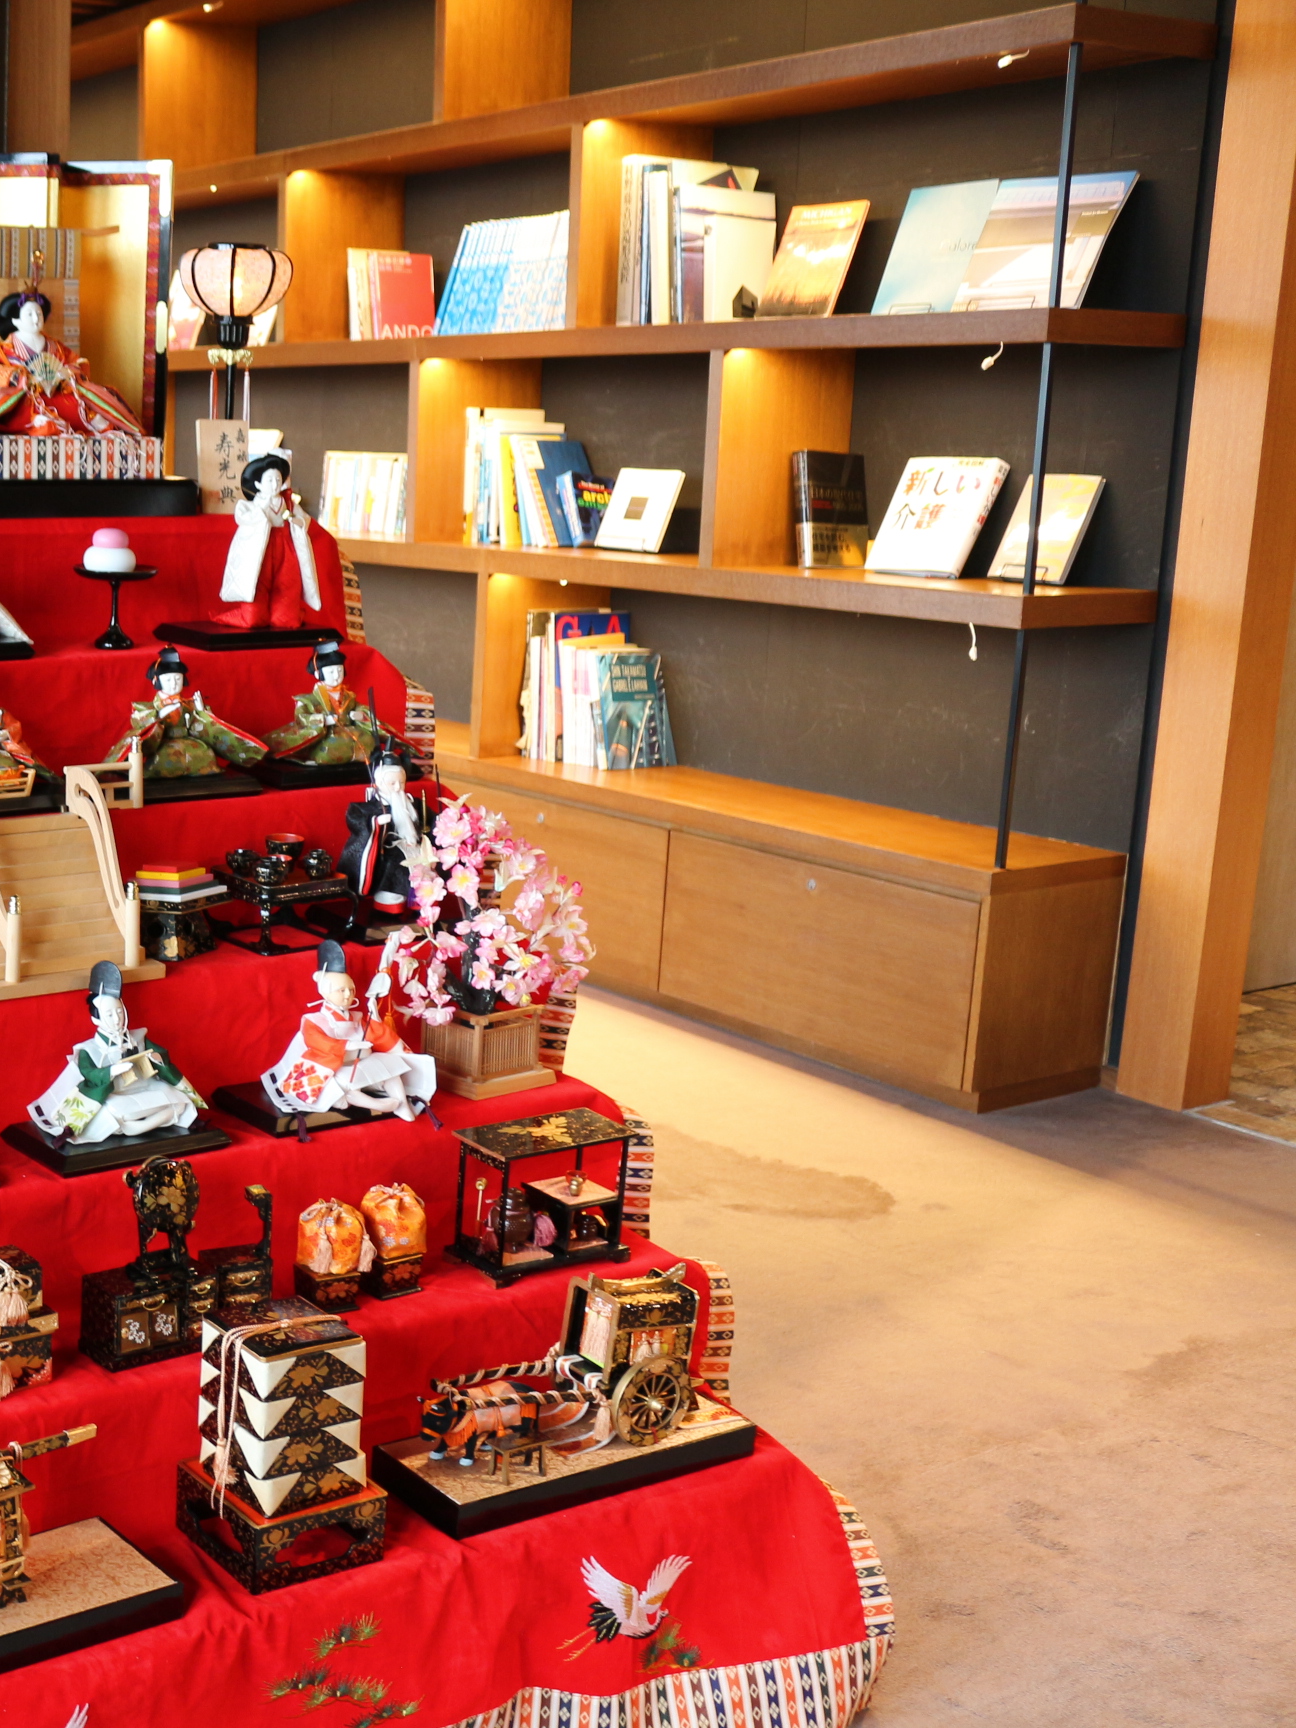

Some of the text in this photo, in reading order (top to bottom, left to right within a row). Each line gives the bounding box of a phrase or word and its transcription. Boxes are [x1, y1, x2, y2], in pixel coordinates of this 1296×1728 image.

[903, 467, 982, 497] 新しい
[891, 502, 947, 531] 介護
